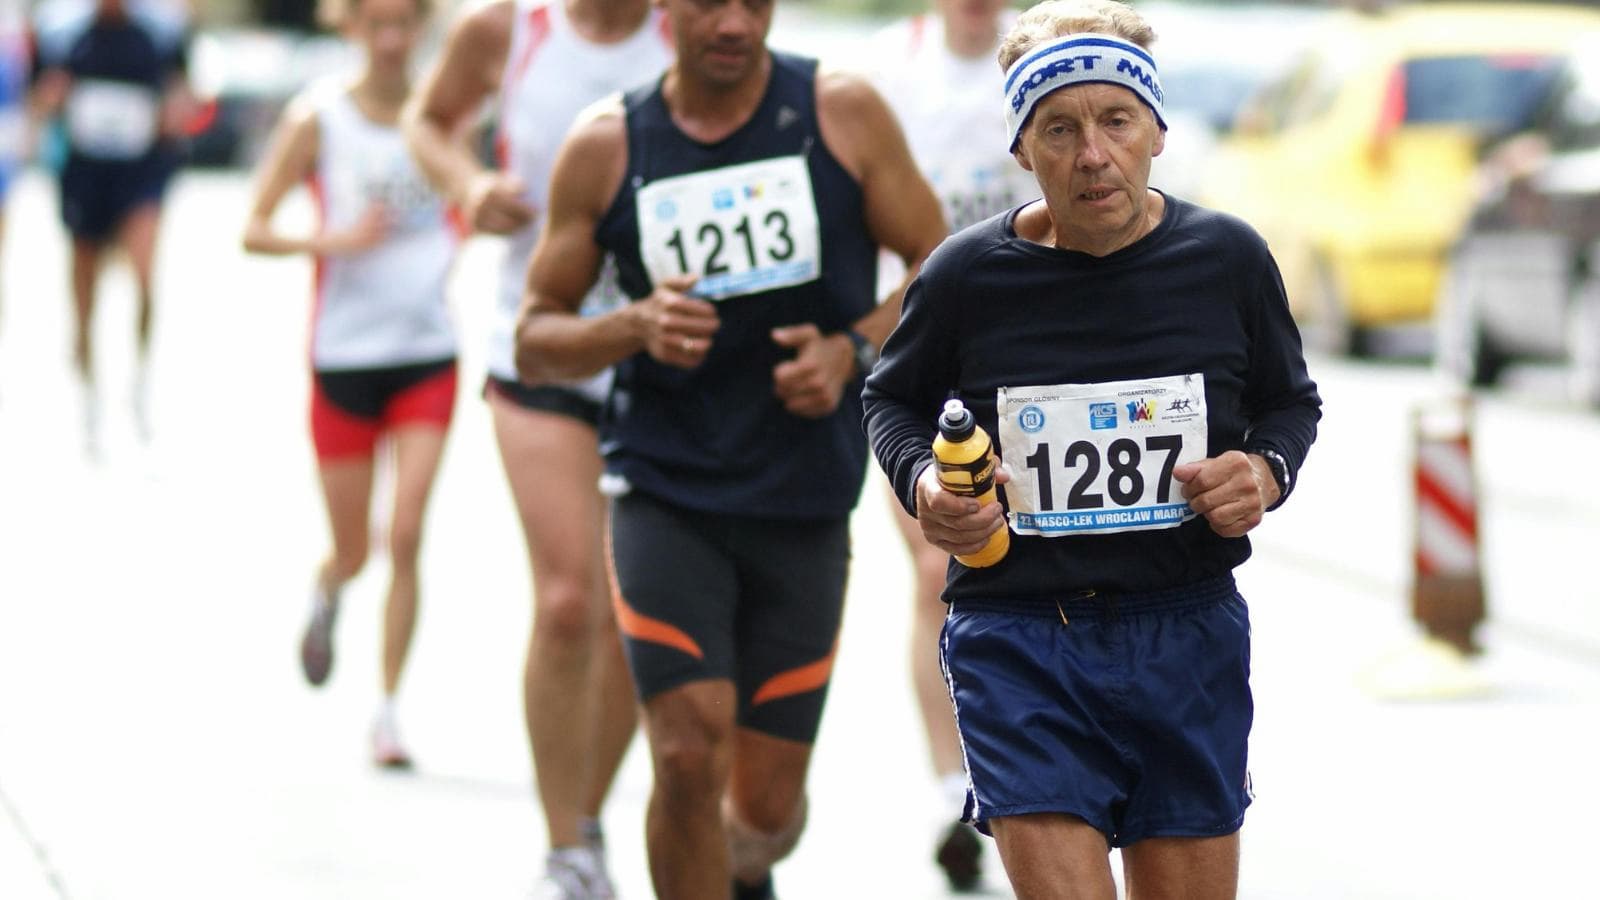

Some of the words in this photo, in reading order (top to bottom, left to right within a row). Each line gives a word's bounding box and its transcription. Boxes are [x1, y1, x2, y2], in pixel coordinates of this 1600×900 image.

[1012, 55, 1102, 114] SPORT
[665, 210, 795, 276] 1213
[1026, 434, 1183, 511] 1287
[1035, 515, 1093, 528] HASCO-LEK
[1095, 510, 1151, 525] WROCŁAW
[1153, 507, 1188, 520] MARA
